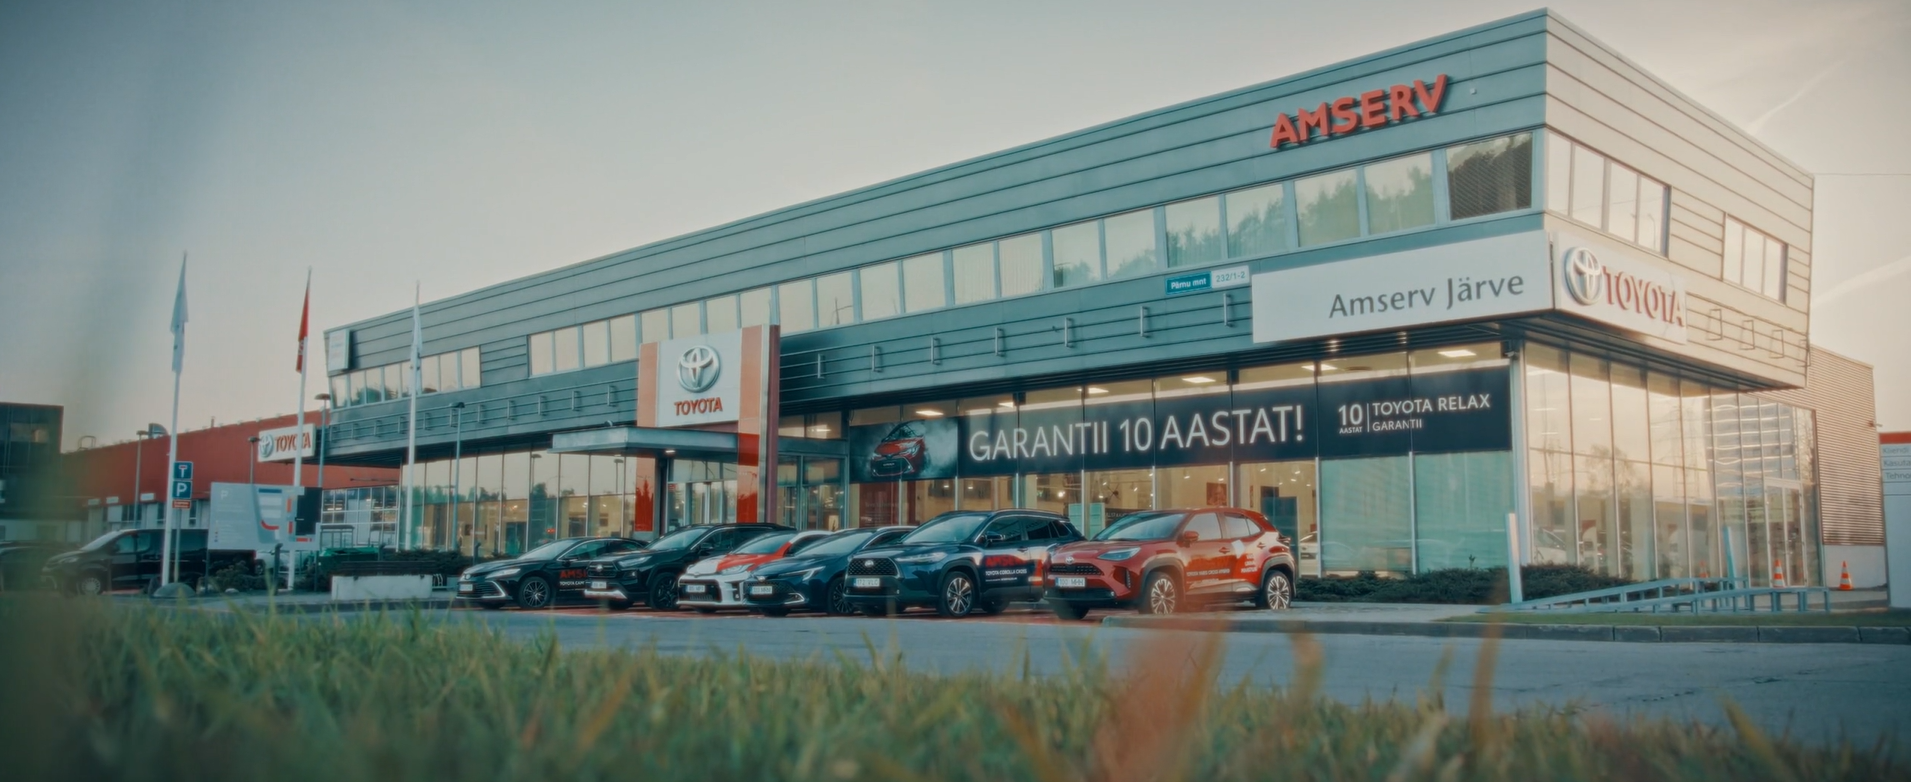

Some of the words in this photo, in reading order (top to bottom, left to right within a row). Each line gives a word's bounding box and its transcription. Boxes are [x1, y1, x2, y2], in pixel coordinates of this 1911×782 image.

[1269, 73, 1448, 149] AMSERV
[1192, 278, 1207, 286] mnt
[1215, 271, 1246, 282] 232/1-2
[1329, 287, 1435, 318] Amserv
[1447, 275, 1524, 310] Järve
[1601, 265, 1685, 327] TOYOTA
[674, 397, 723, 416] TOYOTA
[1338, 403, 1363, 426] 10
[1372, 399, 1433, 416] TOYOTA
[1438, 393, 1491, 411] RELAX
[968, 420, 1108, 461] GARANTII
[1119, 417, 1152, 452] 10
[1160, 405, 1304, 449] AASTAT!
[1339, 426, 1363, 434] AASTAT
[1372, 419, 1423, 431] GARANTII
[176, 484, 187, 497] P
